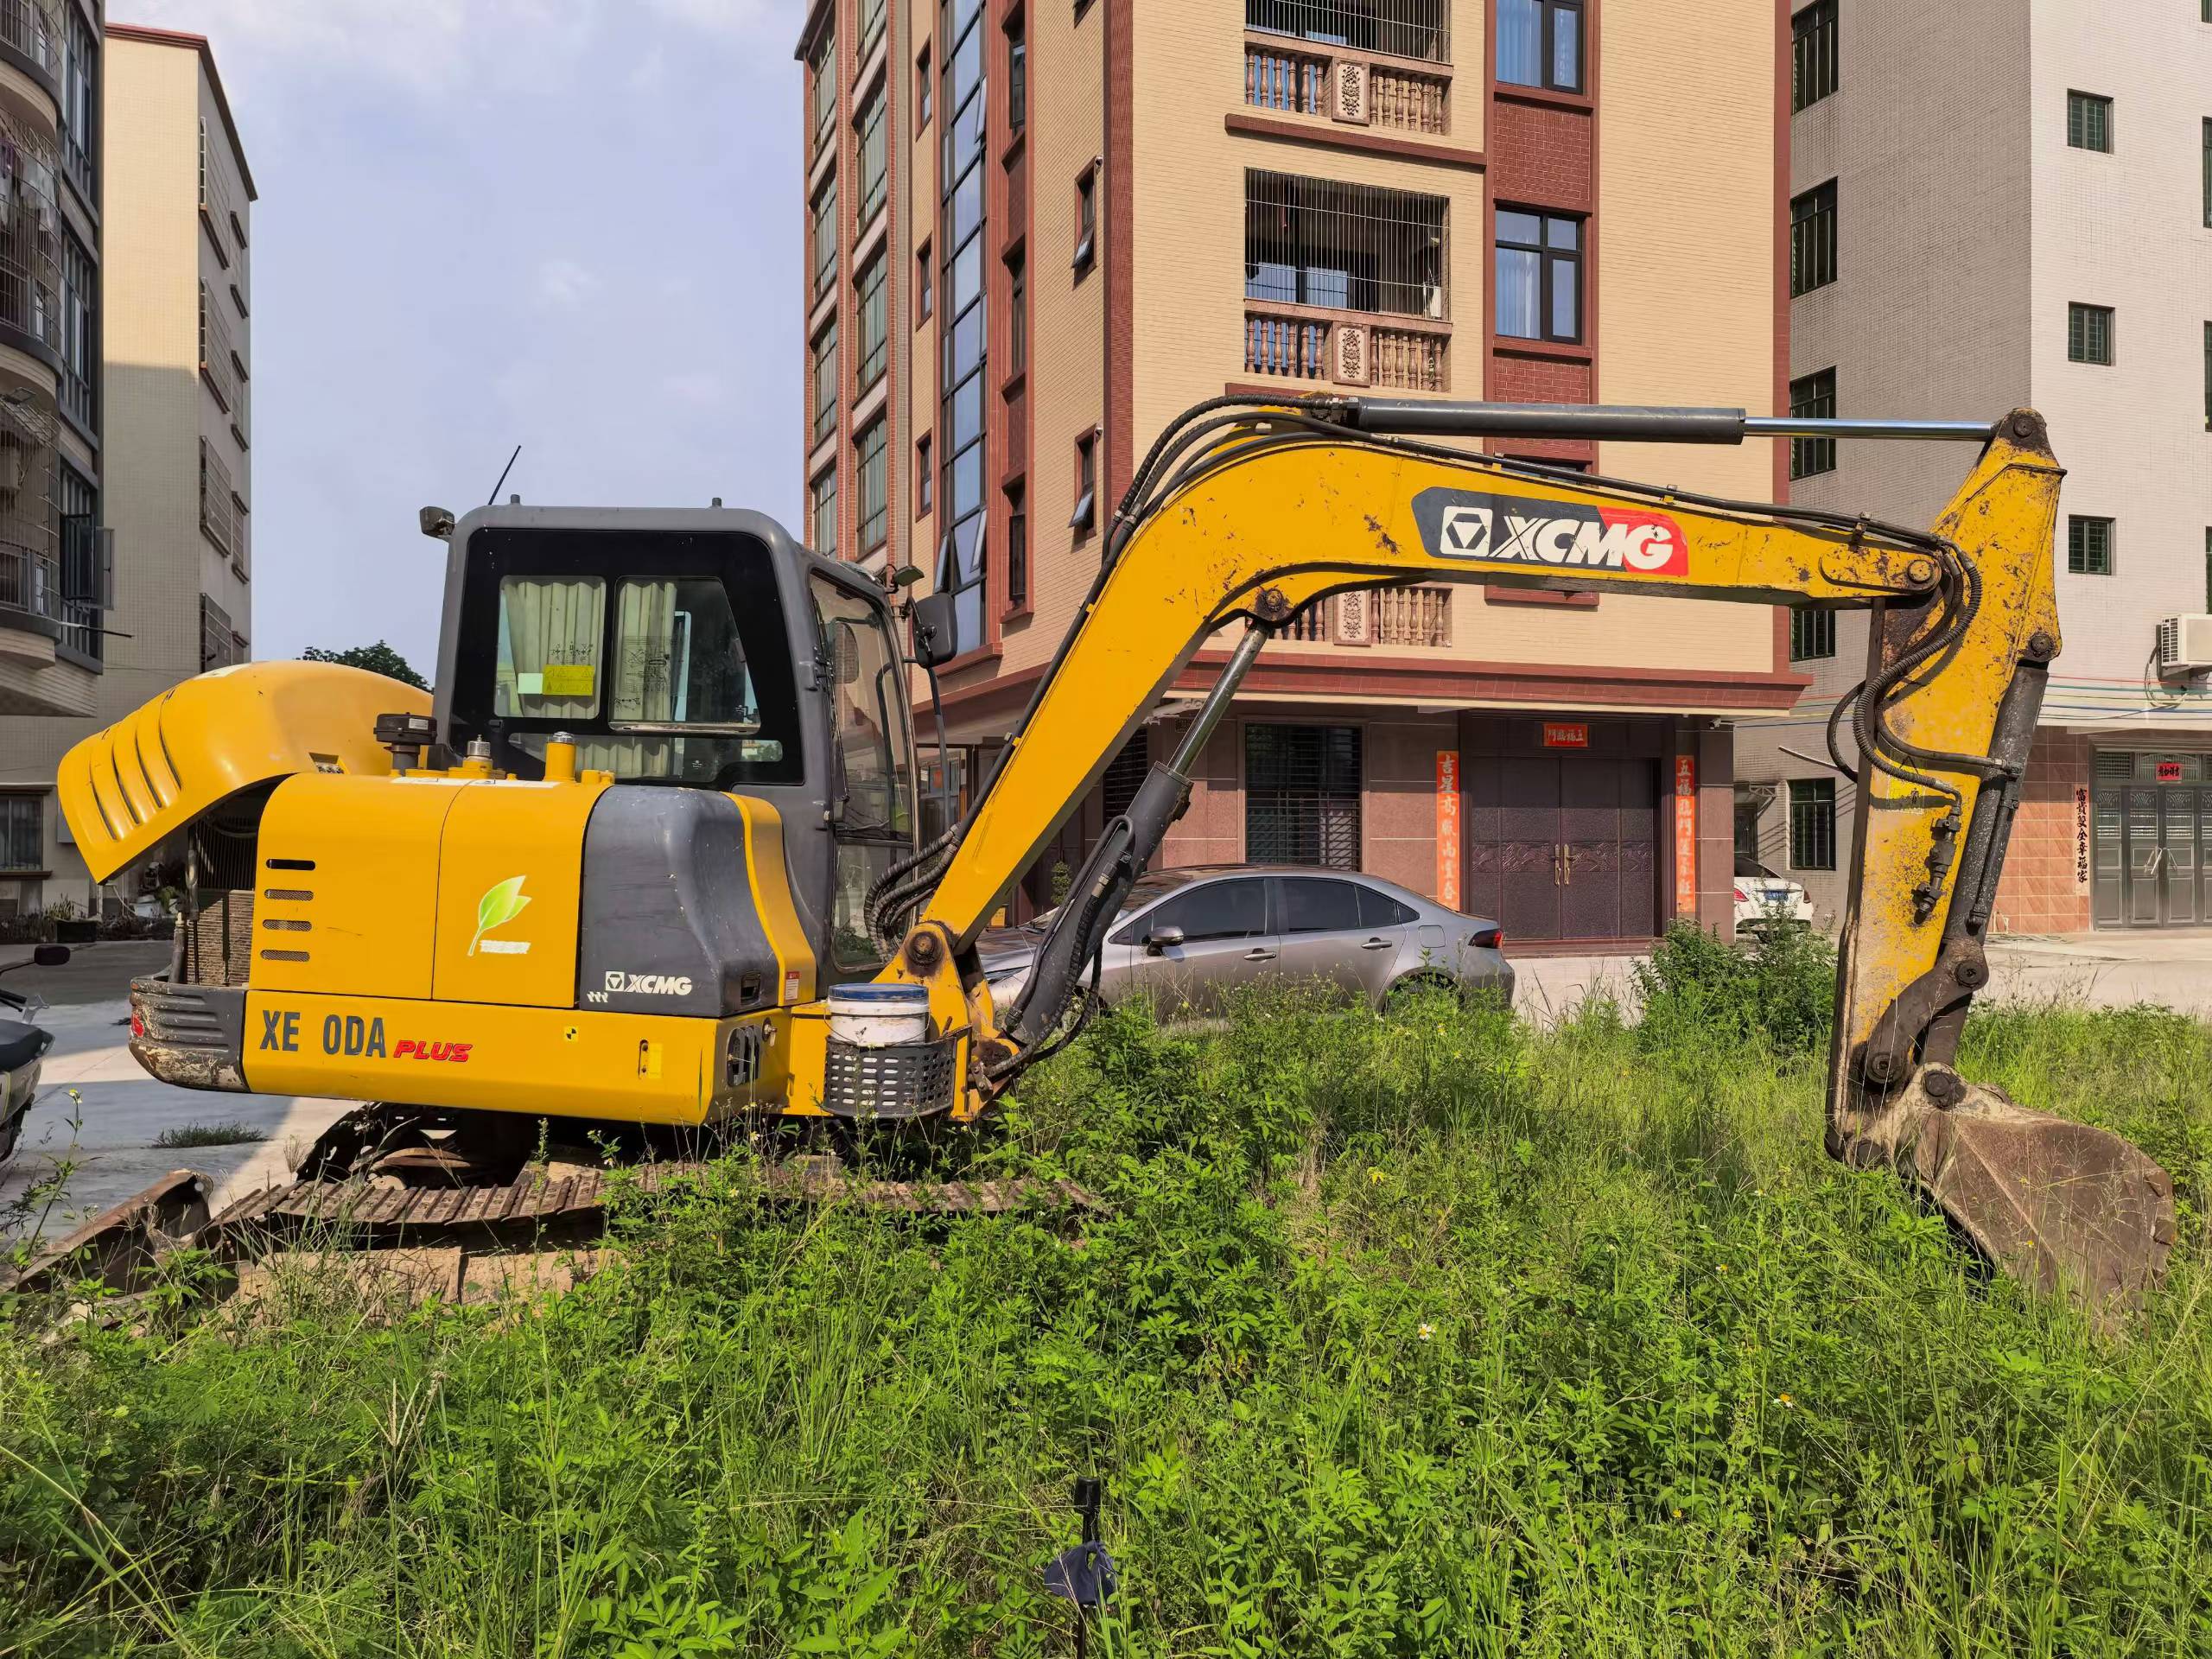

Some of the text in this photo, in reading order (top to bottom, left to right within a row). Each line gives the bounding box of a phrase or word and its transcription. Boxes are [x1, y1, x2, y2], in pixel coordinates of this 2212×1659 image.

[1489, 516, 1674, 569] XCMG
[624, 974, 692, 995] XCMG
[259, 1009, 301, 1052] XE
[393, 1039, 474, 1063] PLUS
